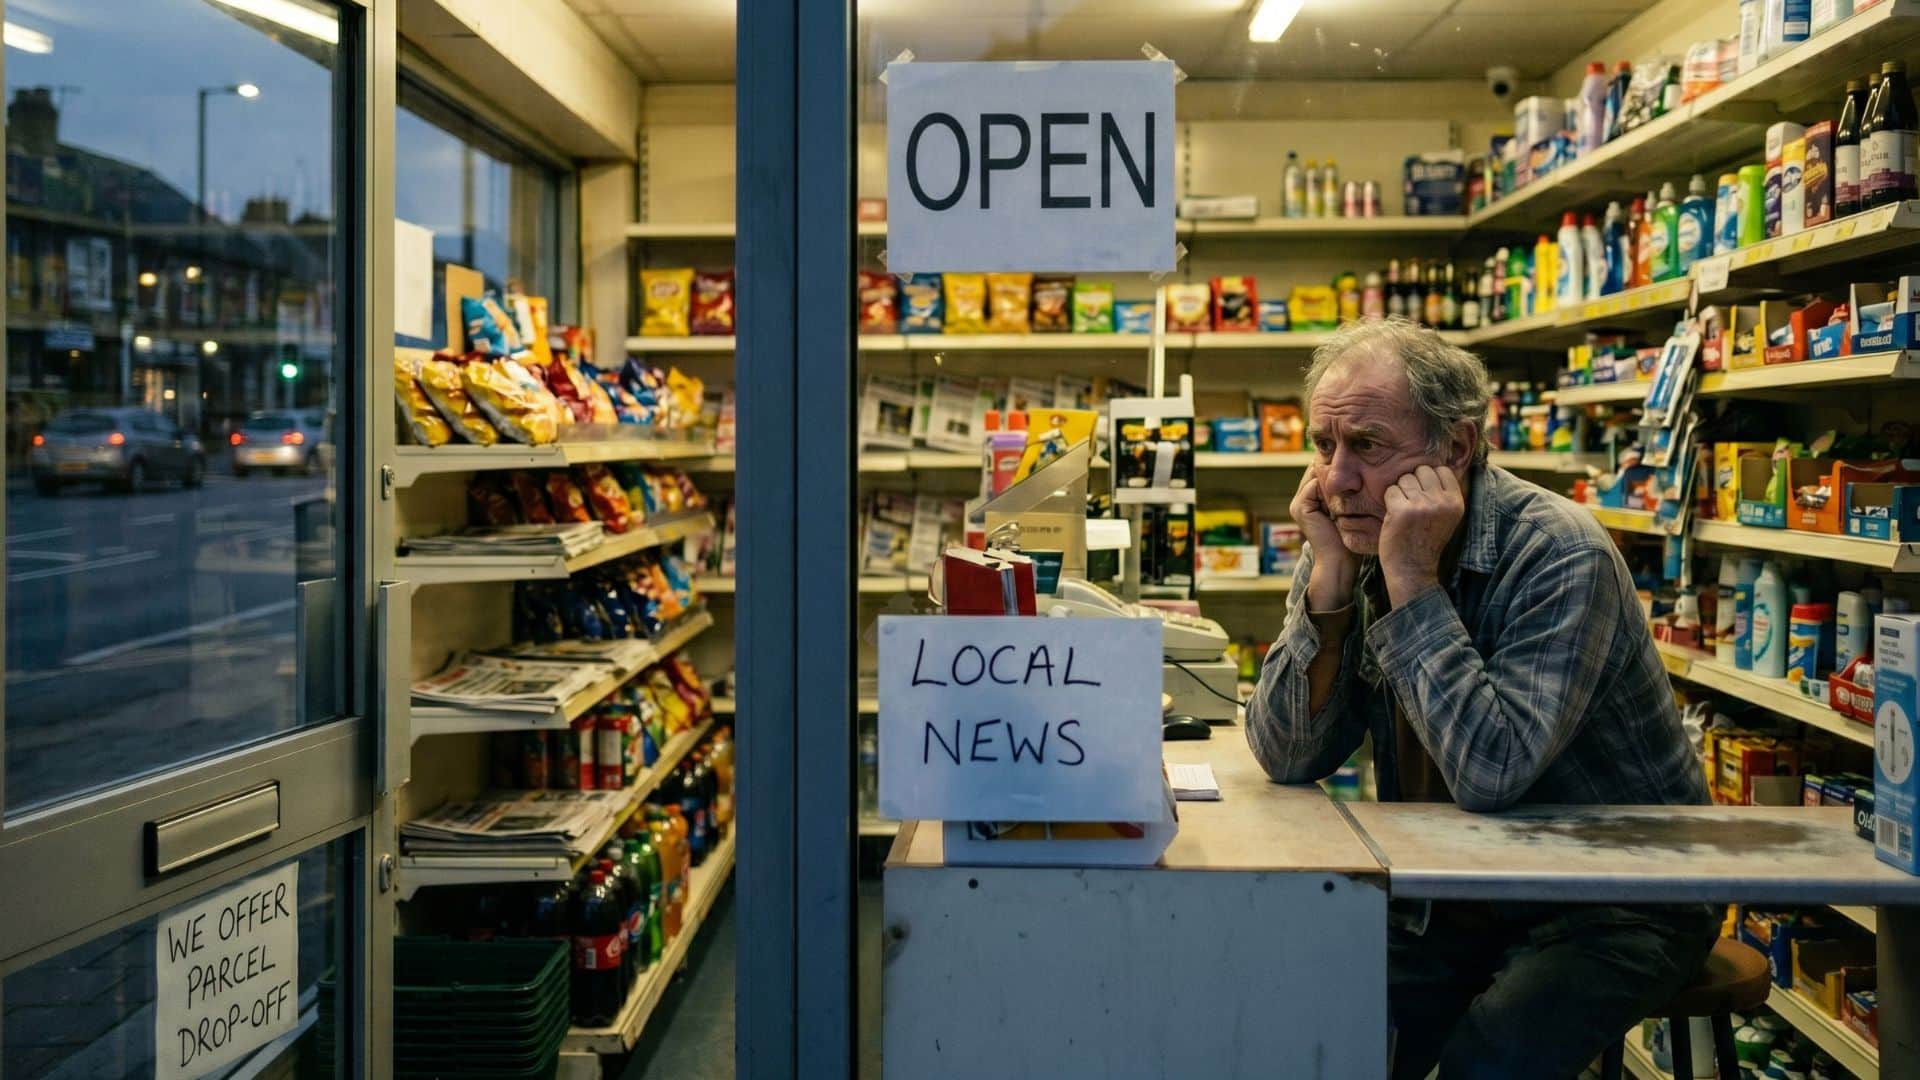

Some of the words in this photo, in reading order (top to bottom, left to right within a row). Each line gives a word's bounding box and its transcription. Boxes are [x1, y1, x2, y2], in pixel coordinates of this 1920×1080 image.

[906, 112, 1155, 211] OPEN
[912, 638, 1101, 687] LOCAL
[924, 719, 1085, 766] NEWS
[168, 912, 207, 963] WE
[219, 882, 289, 941] OFFER
[187, 944, 276, 1010] PARCEL
[177, 980, 290, 1068] DROP-OFF
